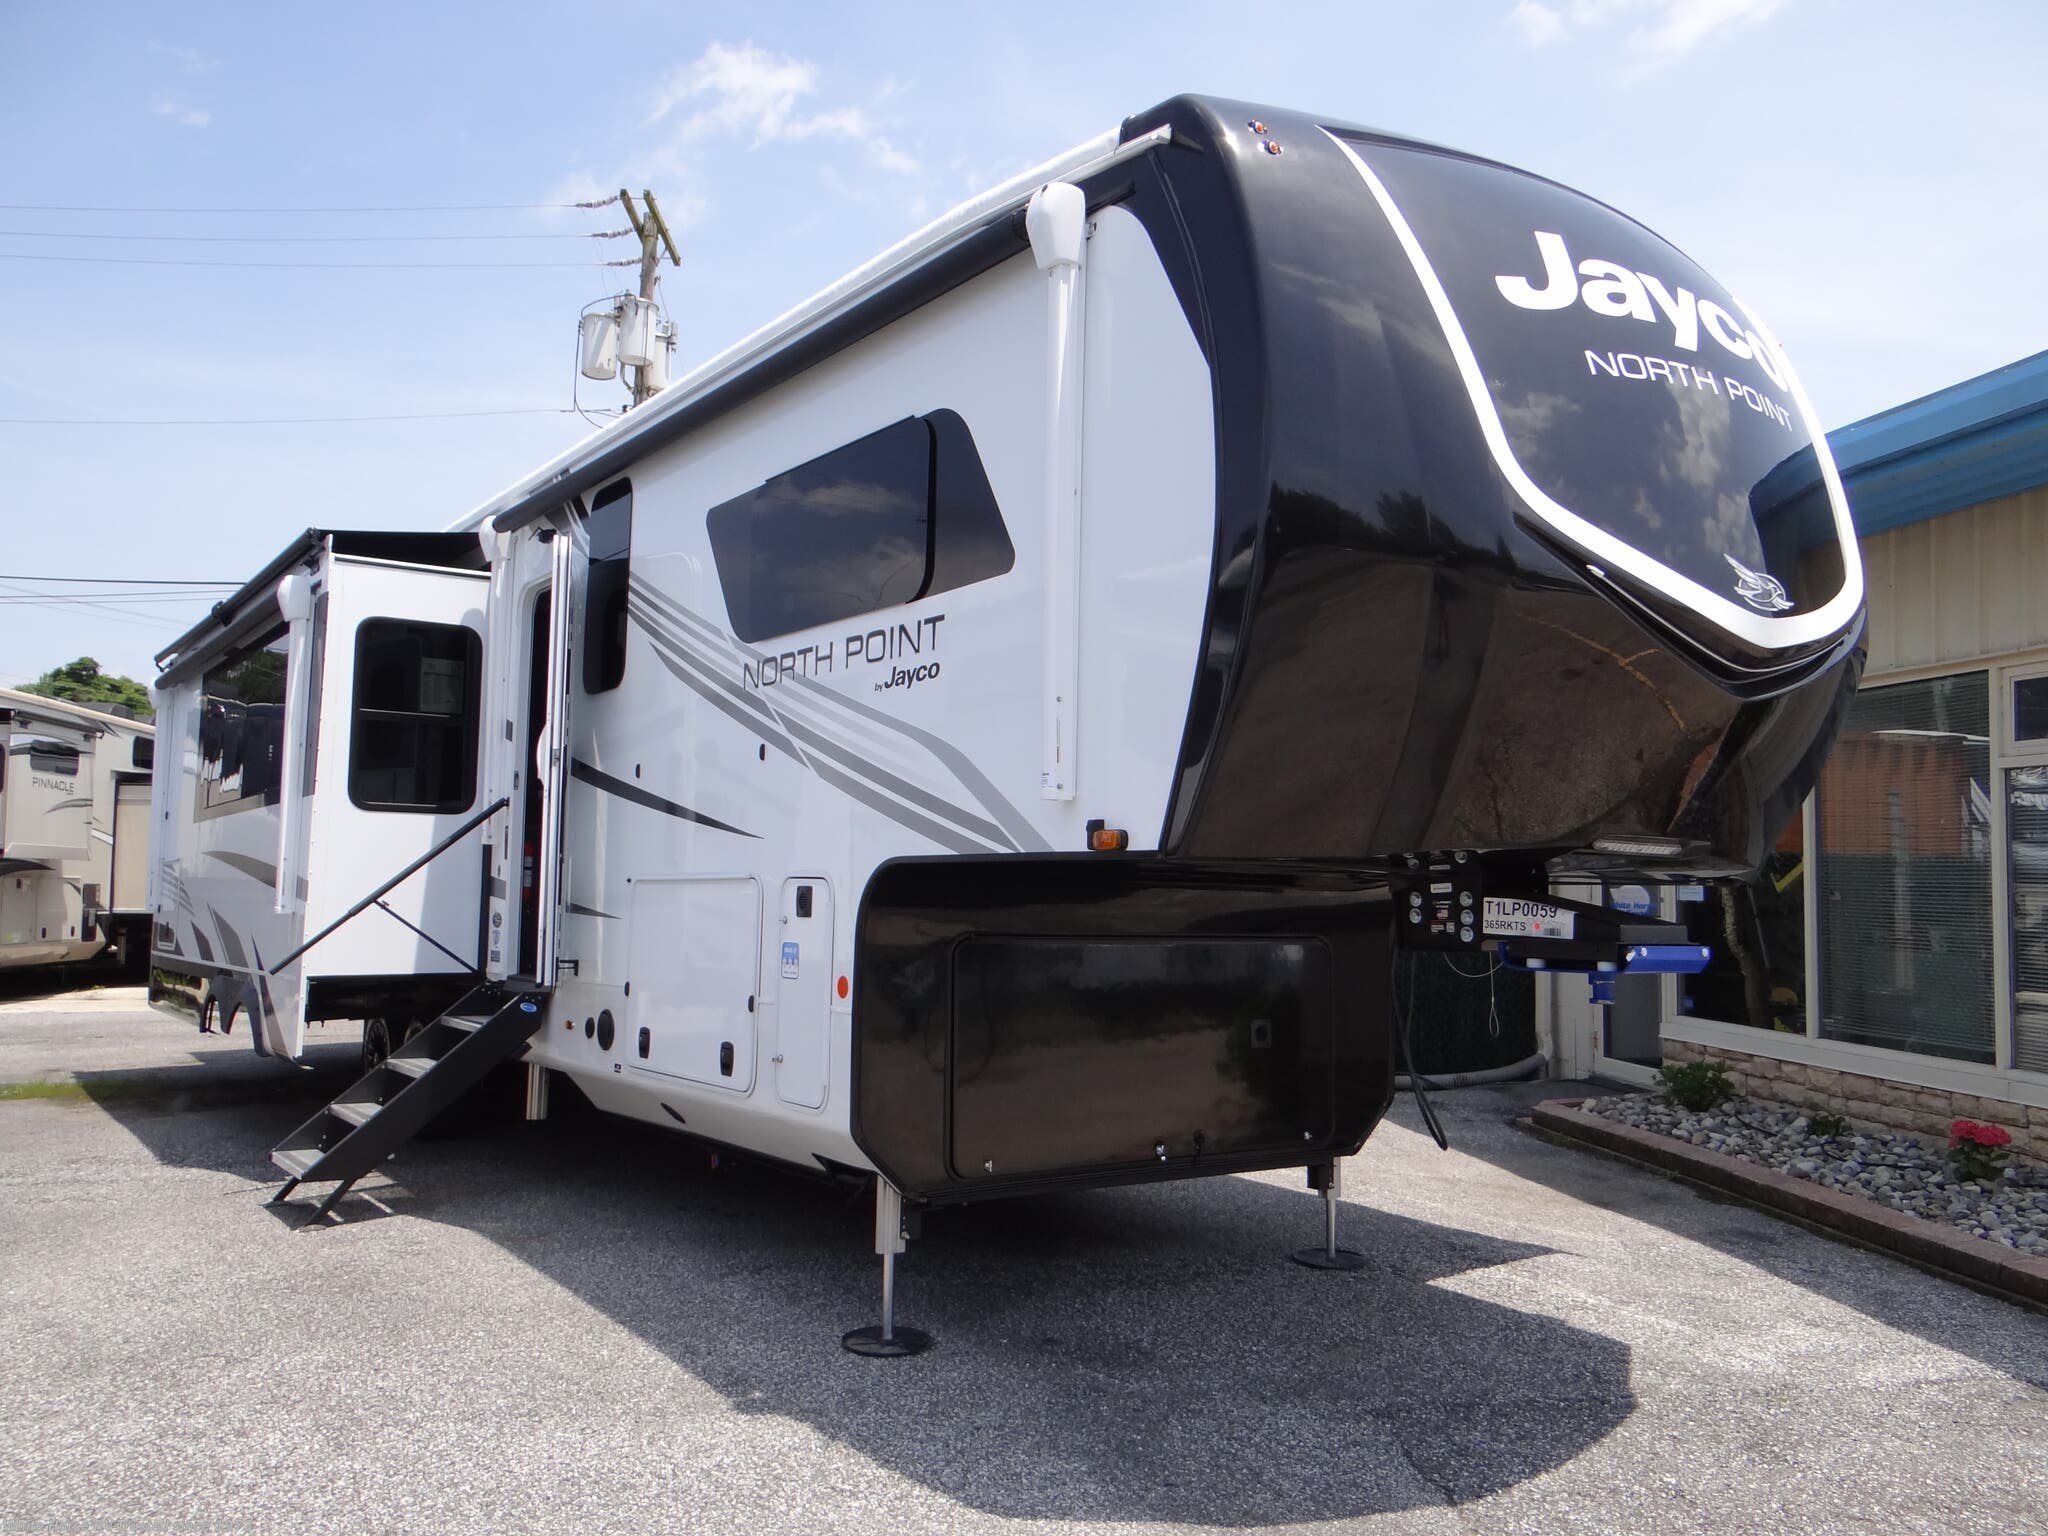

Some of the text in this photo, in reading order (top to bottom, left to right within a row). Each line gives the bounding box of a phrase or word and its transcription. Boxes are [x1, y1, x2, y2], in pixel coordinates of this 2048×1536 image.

[1495, 230, 1789, 392] Jayco
[1584, 349, 1793, 432] NORTH POINT
[743, 613, 946, 691] NORTH POINT
[874, 661, 941, 692] by Jayco
[32, 776, 75, 793] PINNACLE
[1485, 900, 1558, 918] T1LP0059
[1484, 919, 1527, 931] 365RKTS
